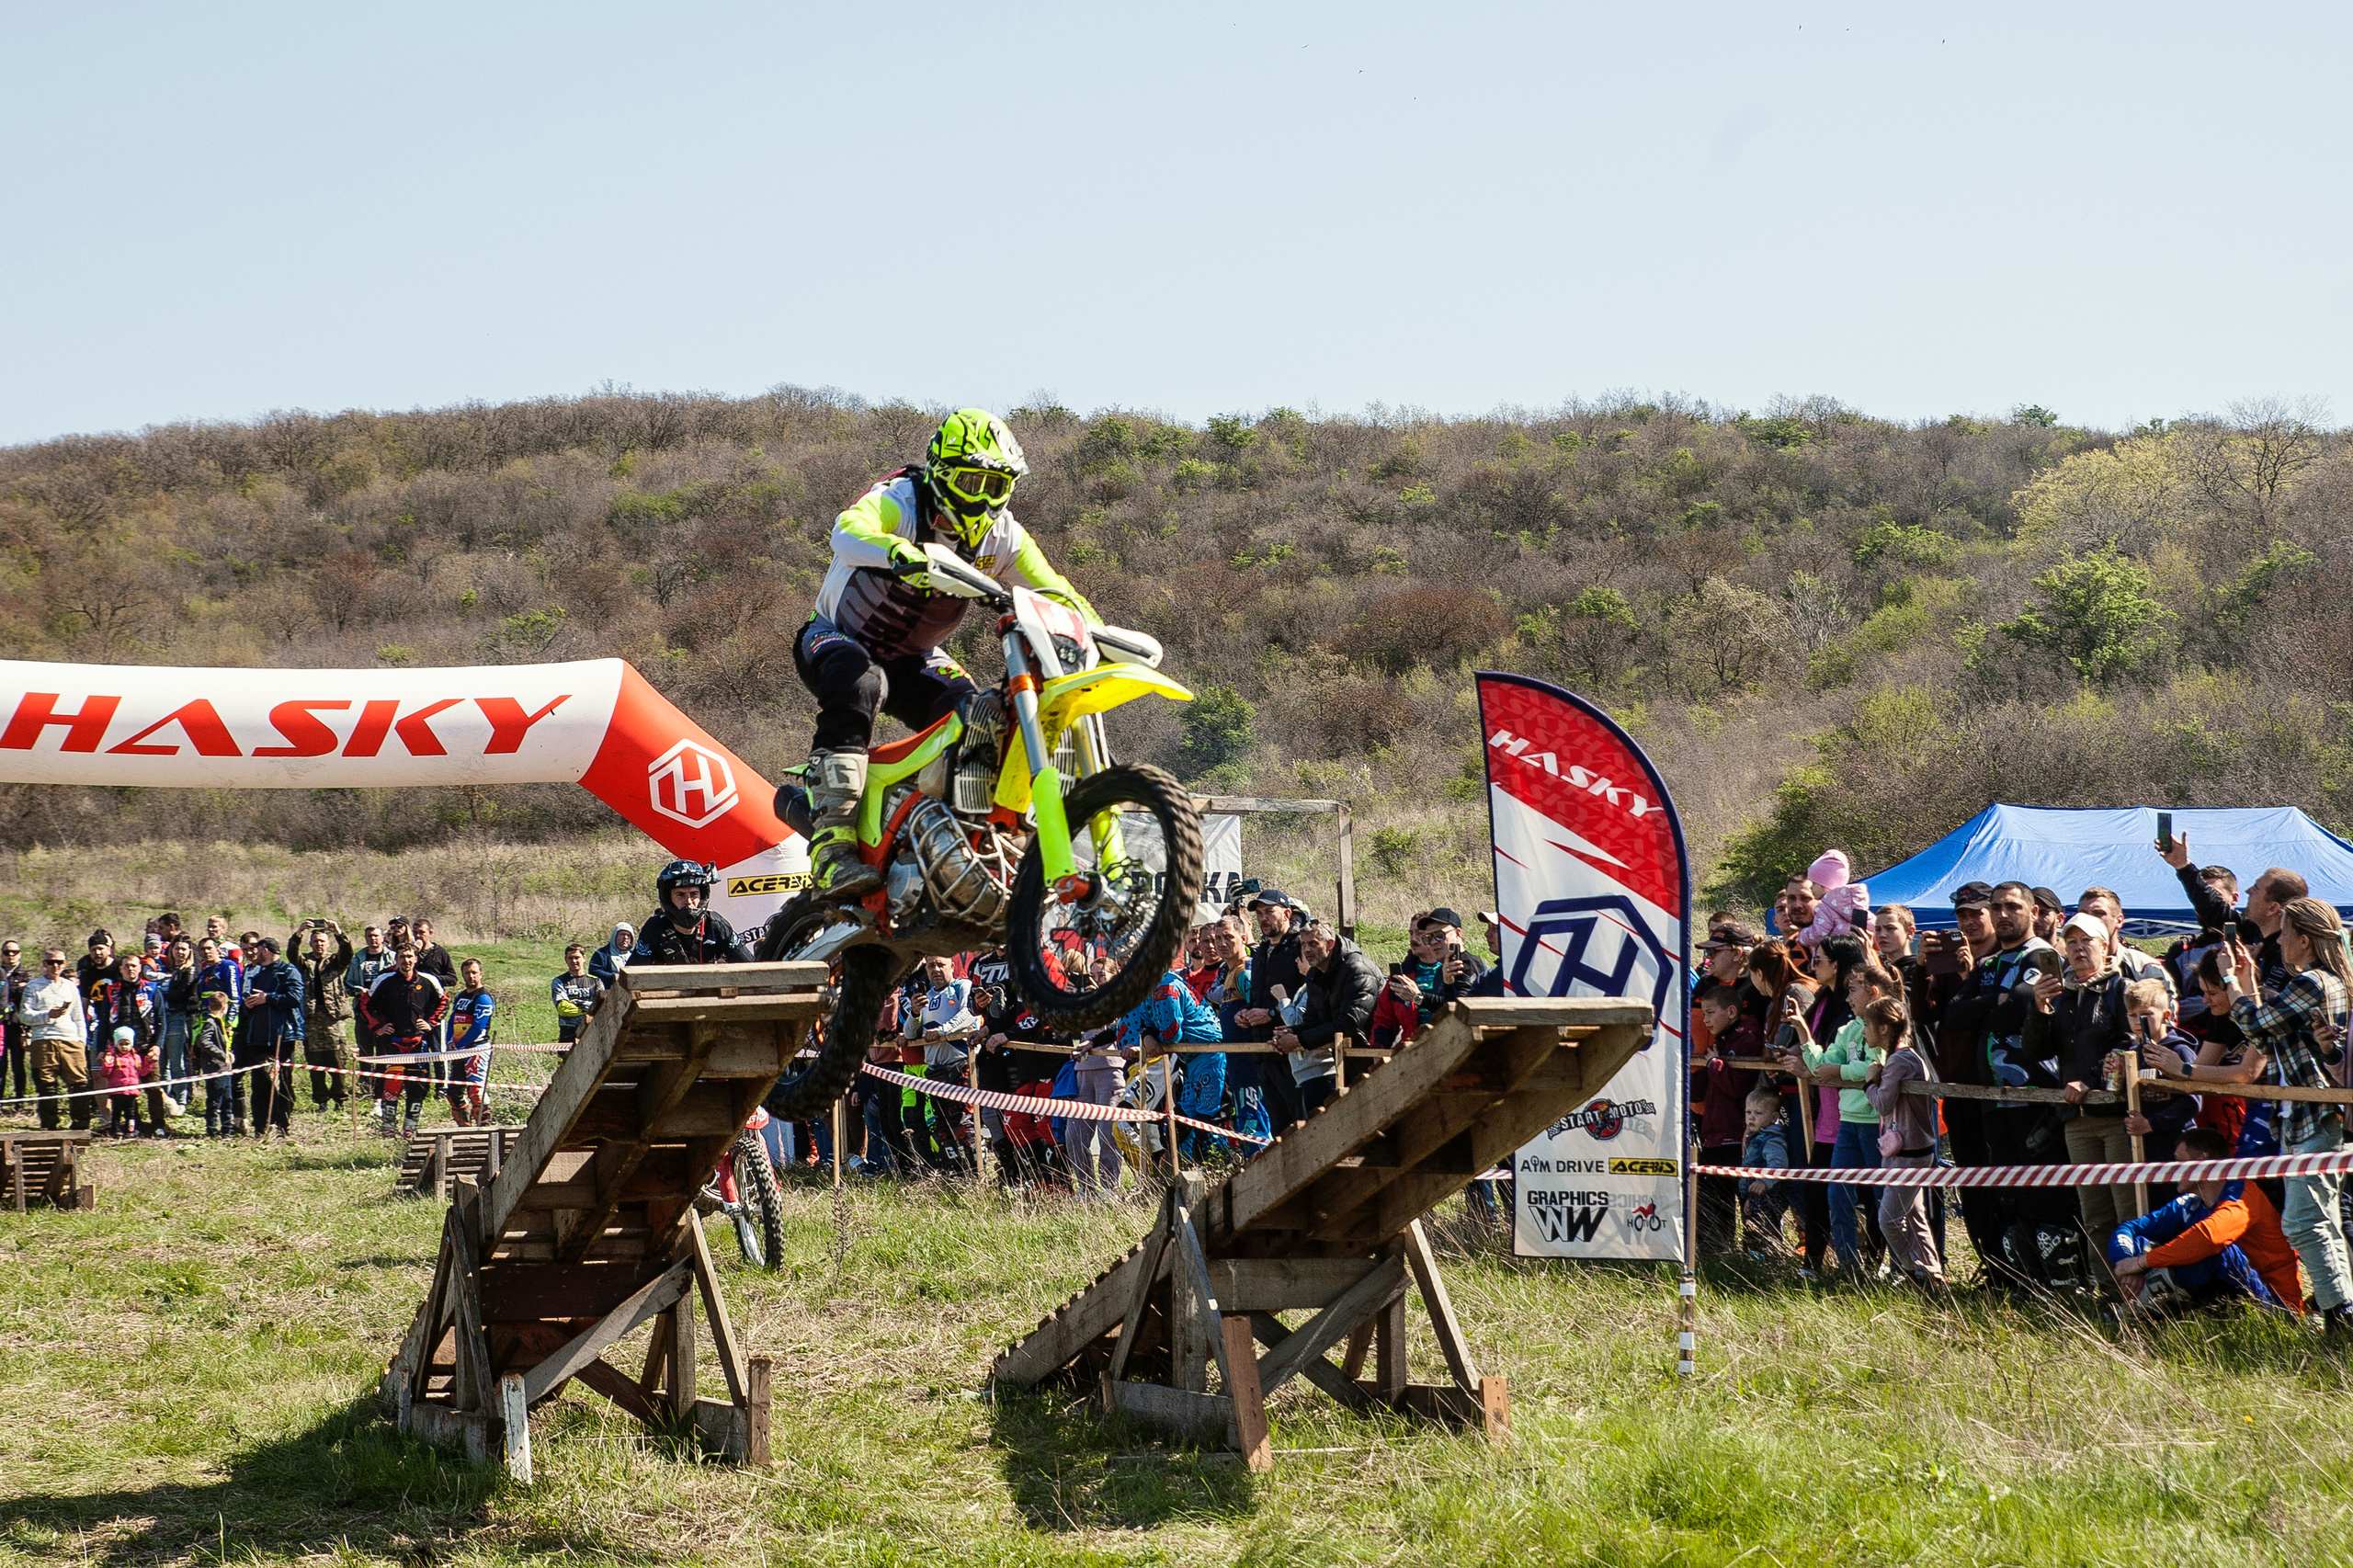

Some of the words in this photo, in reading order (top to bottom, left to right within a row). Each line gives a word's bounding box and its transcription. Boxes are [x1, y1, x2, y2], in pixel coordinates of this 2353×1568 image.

[0, 692, 574, 757] HASKY
[1487, 729, 1665, 818] HASKY
[1560, 1110, 1600, 1130] START
[1608, 1102, 1643, 1119] MOTO
[1556, 1160, 1605, 1173] DRIVE
[1527, 1190, 1609, 1206] GRAPHICS
